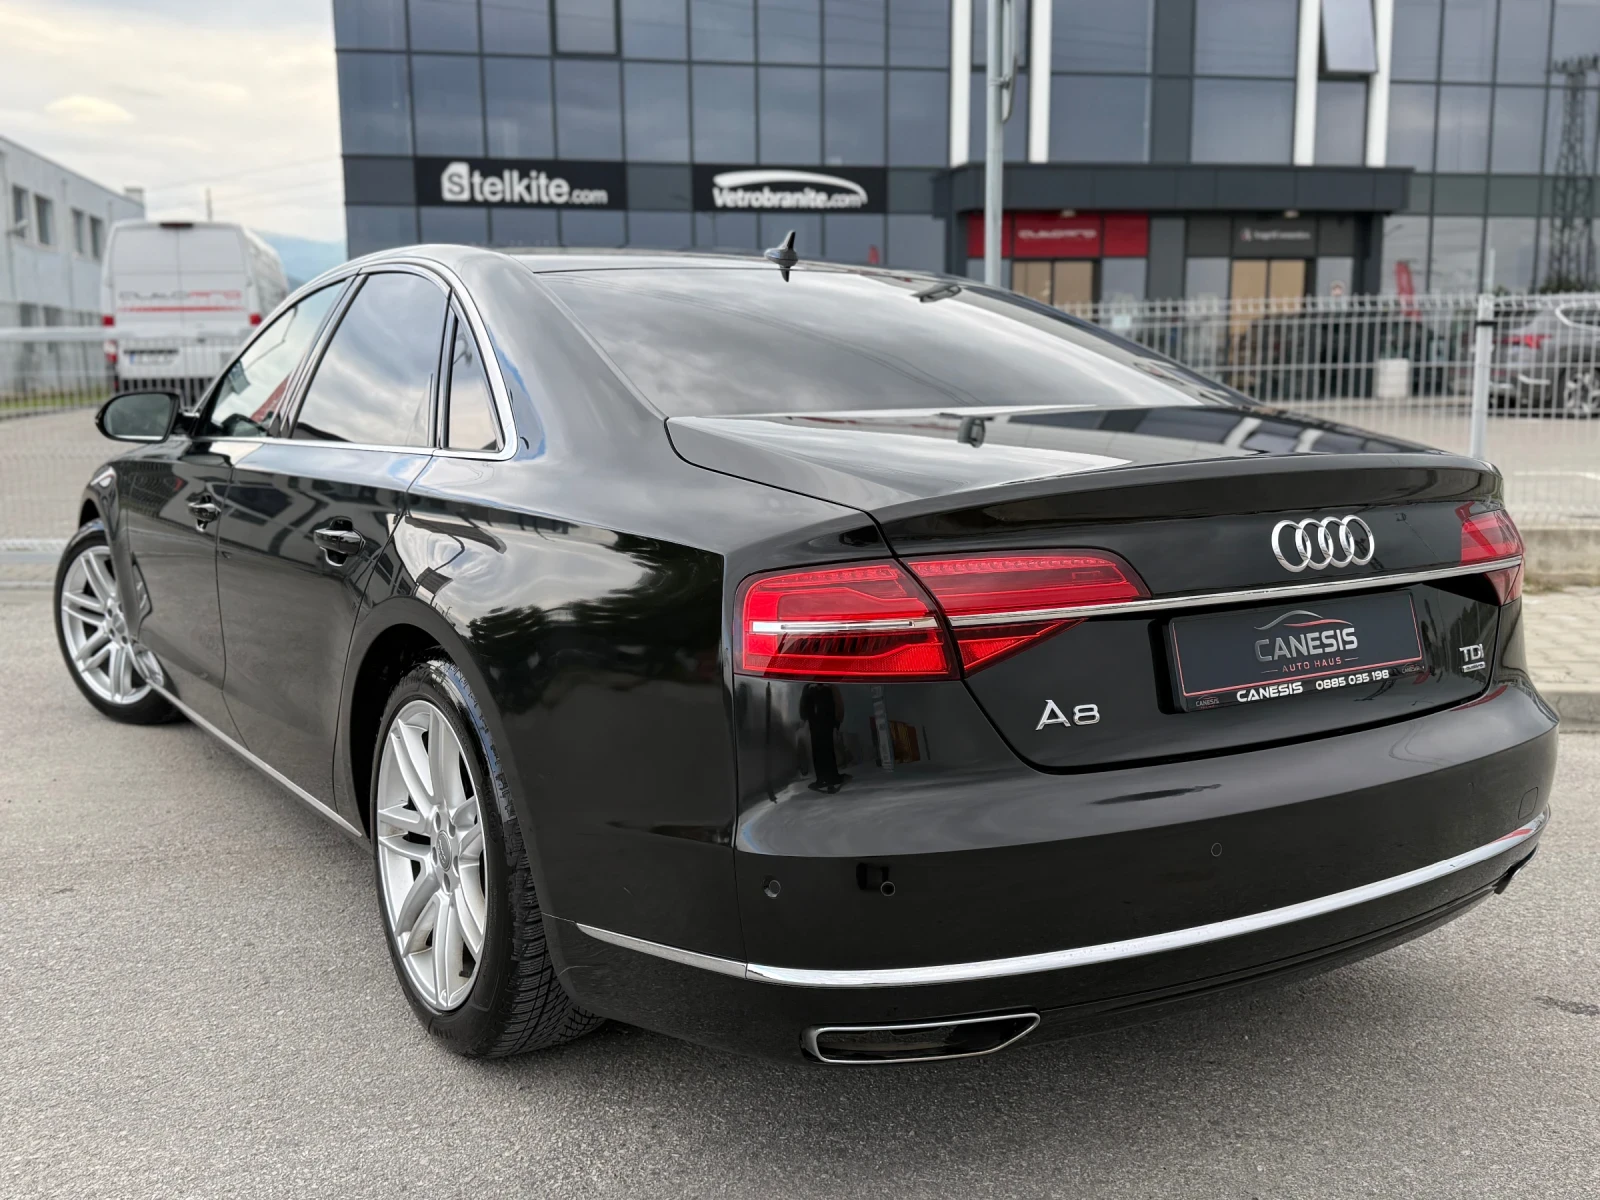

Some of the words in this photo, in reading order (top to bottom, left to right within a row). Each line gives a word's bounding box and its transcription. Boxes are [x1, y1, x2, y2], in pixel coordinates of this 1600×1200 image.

[441, 161, 608, 204] Stelkite.com
[712, 186, 862, 208] Vetrobranite.com
[1255, 627, 1358, 662] CANESIS
[1459, 643, 1485, 662] TDI
[1282, 661, 1310, 673] AUTO
[1314, 657, 1342, 668] HAUS
[1236, 681, 1303, 703] CANESIS
[1315, 676, 1346, 690] 0885
[1348, 672, 1370, 685] 035
[1371, 669, 1390, 681] 198
[1035, 699, 1101, 731] A8
